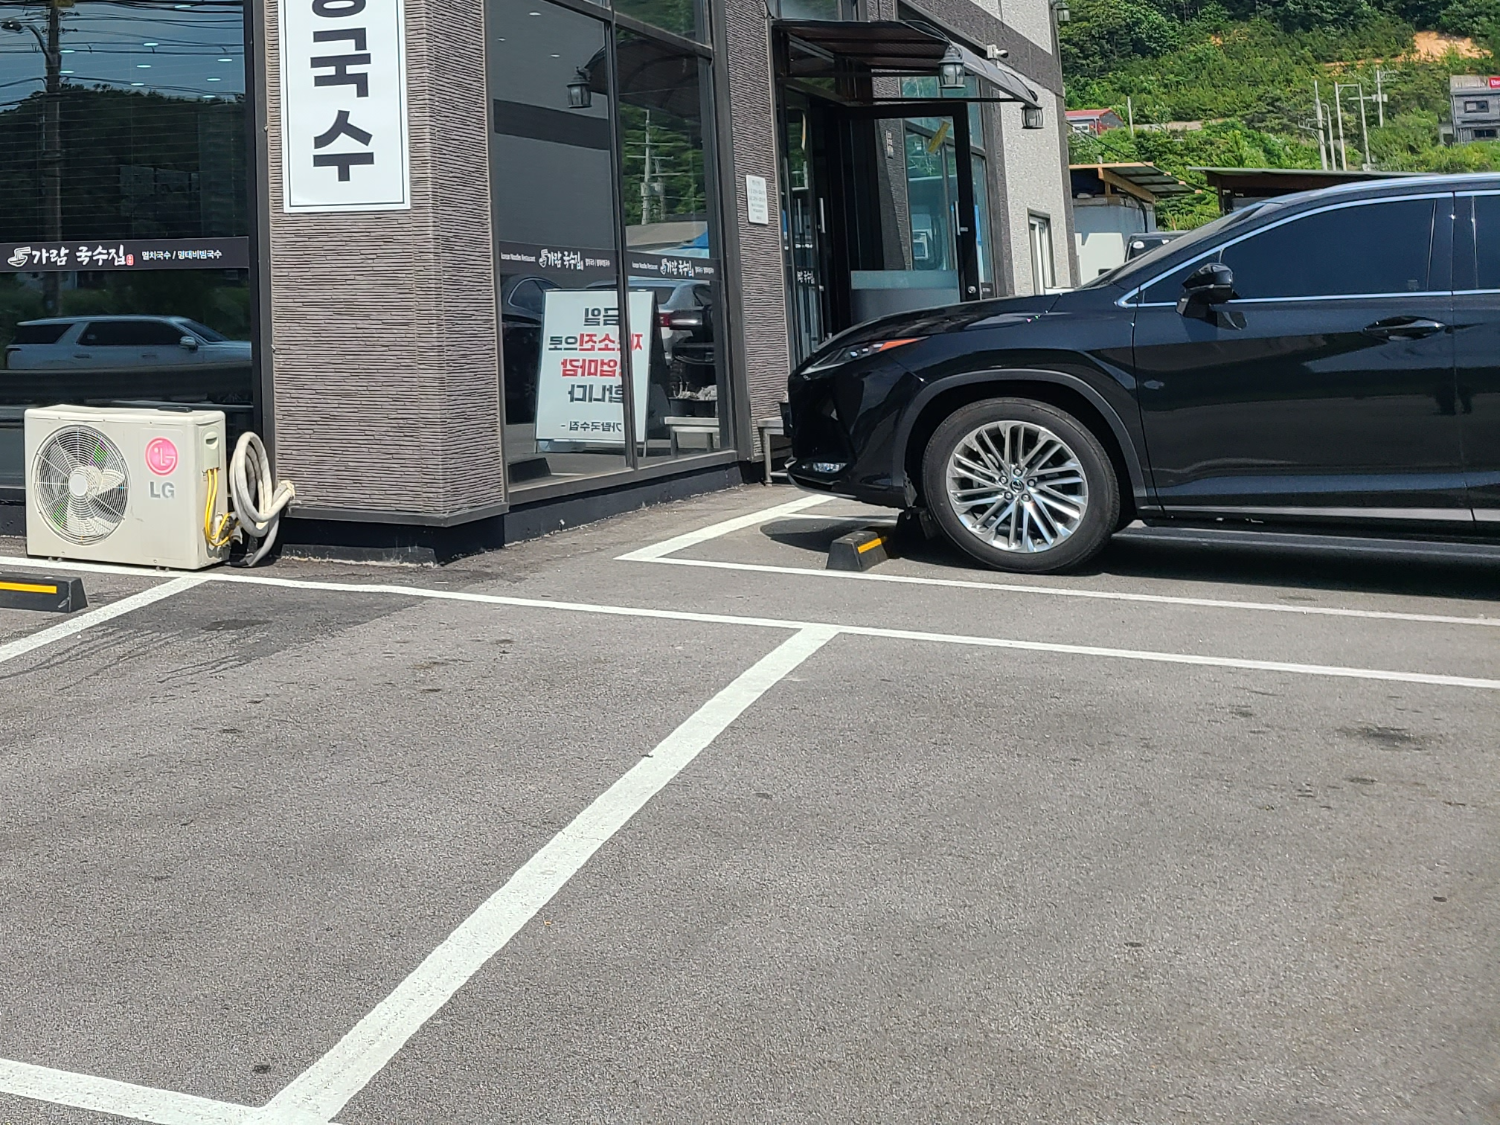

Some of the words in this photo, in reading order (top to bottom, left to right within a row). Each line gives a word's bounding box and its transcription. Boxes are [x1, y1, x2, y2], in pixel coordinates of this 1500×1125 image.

[31, 246, 69, 266] 가람
[76, 244, 126, 266] 국수집
[149, 481, 175, 500] LG
